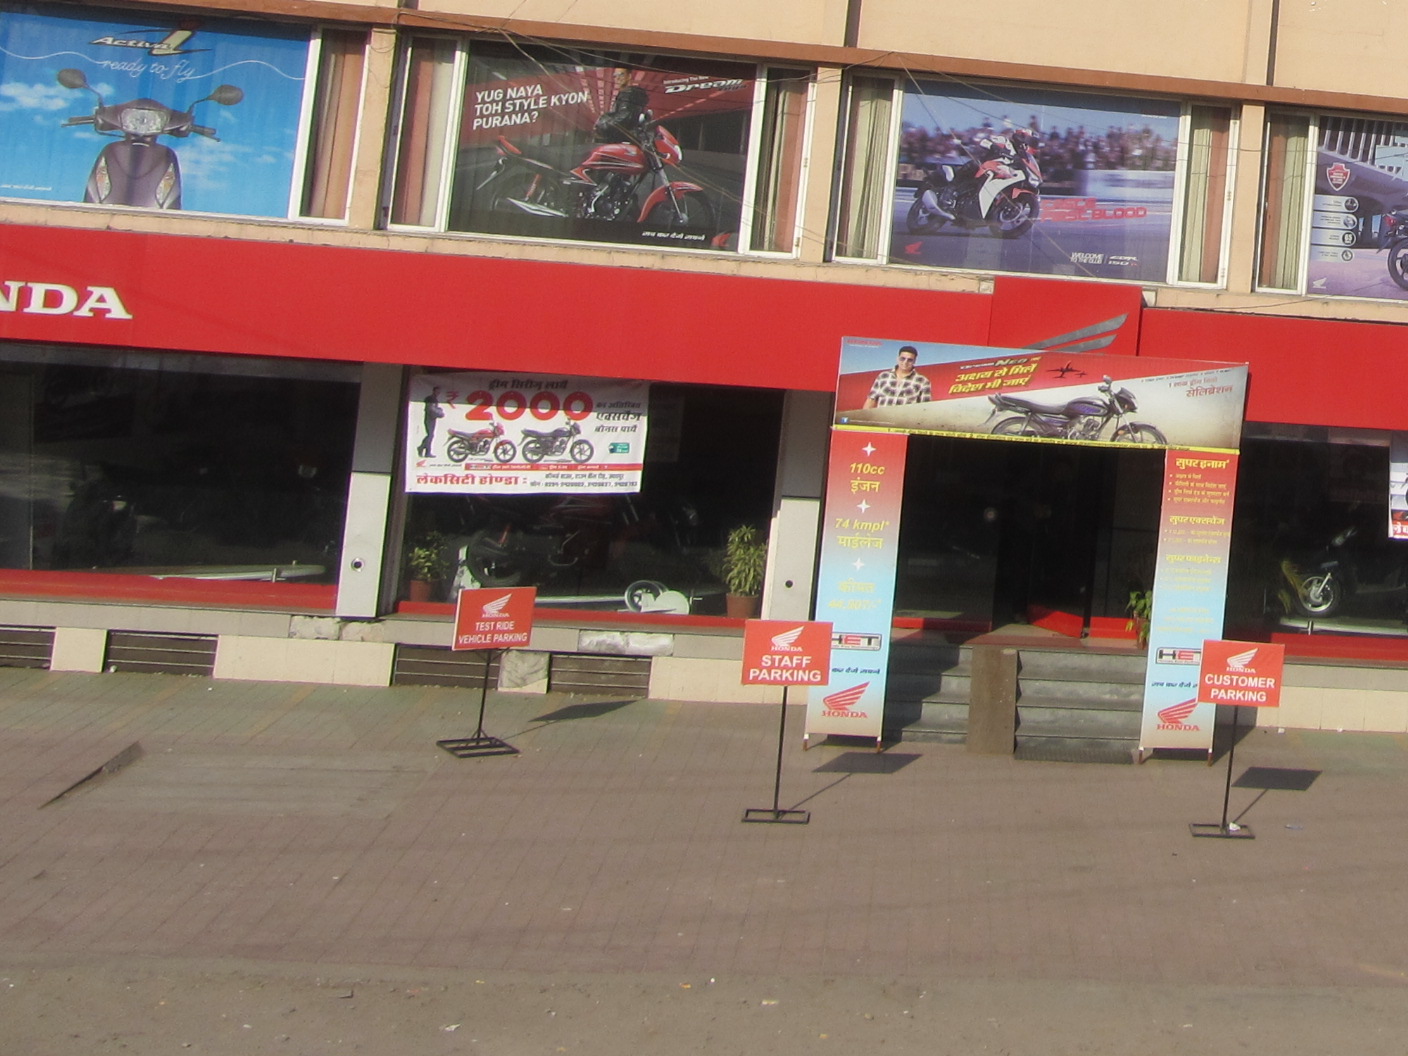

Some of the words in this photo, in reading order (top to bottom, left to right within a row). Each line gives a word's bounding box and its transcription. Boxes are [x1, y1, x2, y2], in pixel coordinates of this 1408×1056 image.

[101, 58, 146, 78] ready
[149, 61, 167, 75] to
[164, 59, 196, 83] fly
[664, 78, 743, 94] Dream
[475, 88, 503, 103] YUG
[506, 84, 543, 100] NAYA
[474, 102, 502, 116] TOH
[504, 96, 548, 113] STYLE
[550, 91, 588, 107] KYON
[472, 111, 539, 131] PURANA?
[465, 390, 594, 421] 2000
[849, 462, 886, 475] 110cc
[1175, 457, 1198, 470] सुपर
[416, 473, 477, 485] लेकसिटी
[850, 476, 881, 494] इंजन
[834, 518, 849, 529] 74
[475, 621, 496, 631] TEST
[496, 621, 515, 631] RIDE
[458, 634, 492, 644] VEHICLE
[493, 632, 528, 643] PARKING
[761, 654, 812, 668] STAFF
[749, 668, 821, 682] PARKING
[1204, 673, 1275, 689] CUSTOMER
[1210, 688, 1267, 702] PARKING
[822, 710, 868, 718] HONDA
